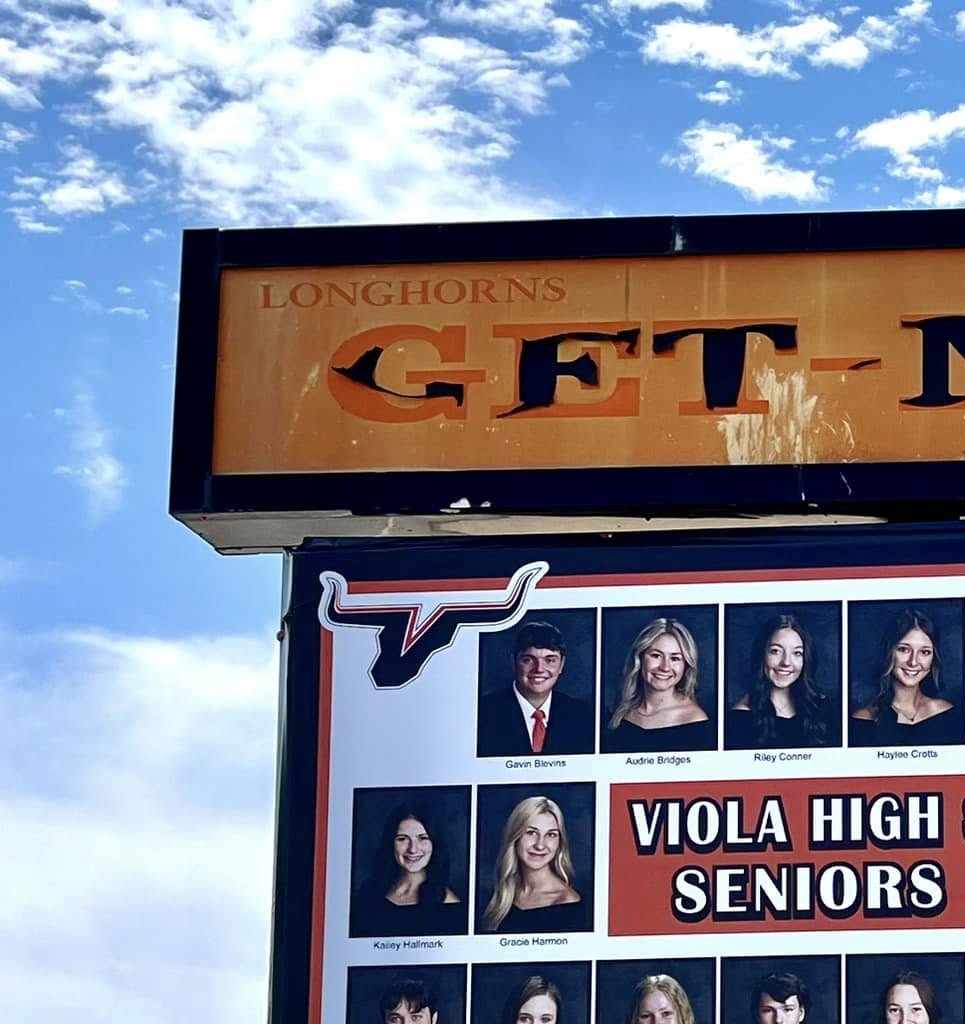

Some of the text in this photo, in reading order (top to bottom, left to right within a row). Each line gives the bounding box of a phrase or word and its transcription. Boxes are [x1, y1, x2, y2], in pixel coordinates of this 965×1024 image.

[262, 277, 567, 309] LONGHORNS
[625, 755, 692, 767] Audrie Bridges
[753, 752, 813, 764] Riley Conner
[876, 749, 939, 761] Haylee Crotts
[504, 759, 567, 769] Gavin Blevins
[630, 799, 792, 854] VIOLA
[809, 791, 945, 850] HIGH
[671, 860, 947, 922] SENIORS
[402, 939, 444, 950] Hallmark
[499, 936, 569, 948] Gracie Harmon
